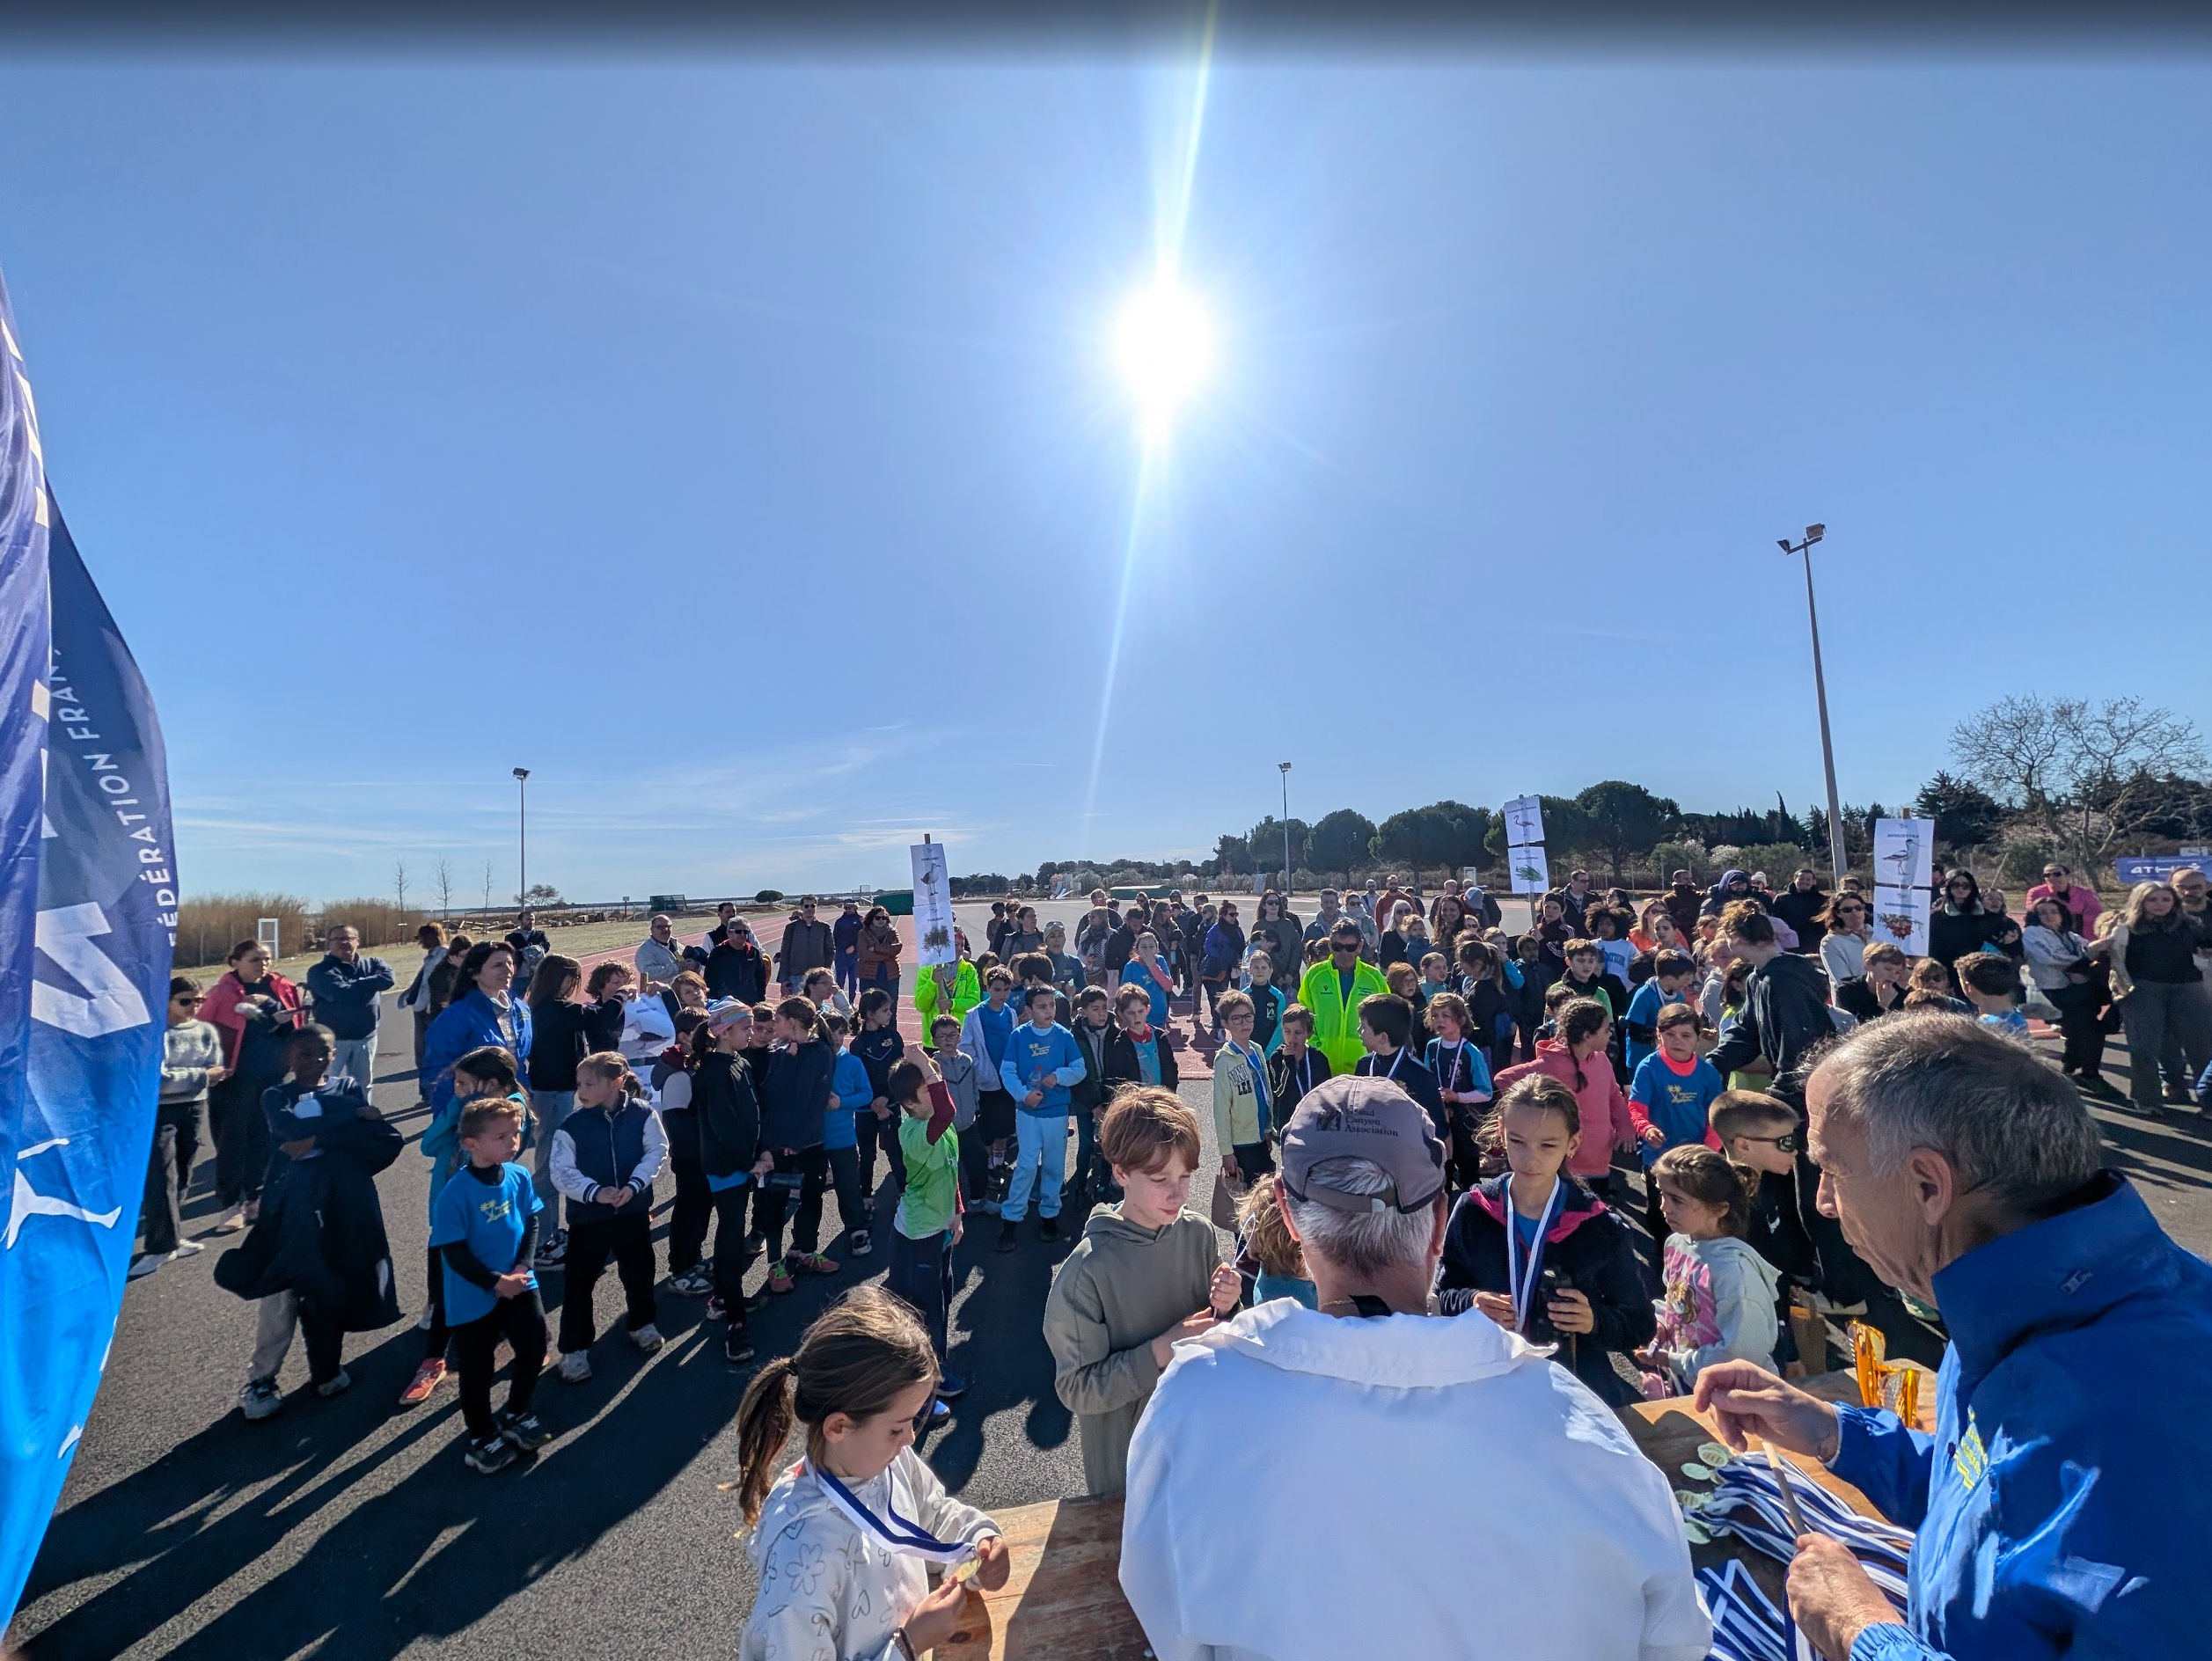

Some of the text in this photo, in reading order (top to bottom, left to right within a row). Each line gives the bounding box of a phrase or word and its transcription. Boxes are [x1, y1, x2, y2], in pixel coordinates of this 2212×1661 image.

[50, 648, 100, 739] FRAN
[1345, 1116, 1381, 1126] Canyon
[1344, 1124, 1399, 1138] Association
